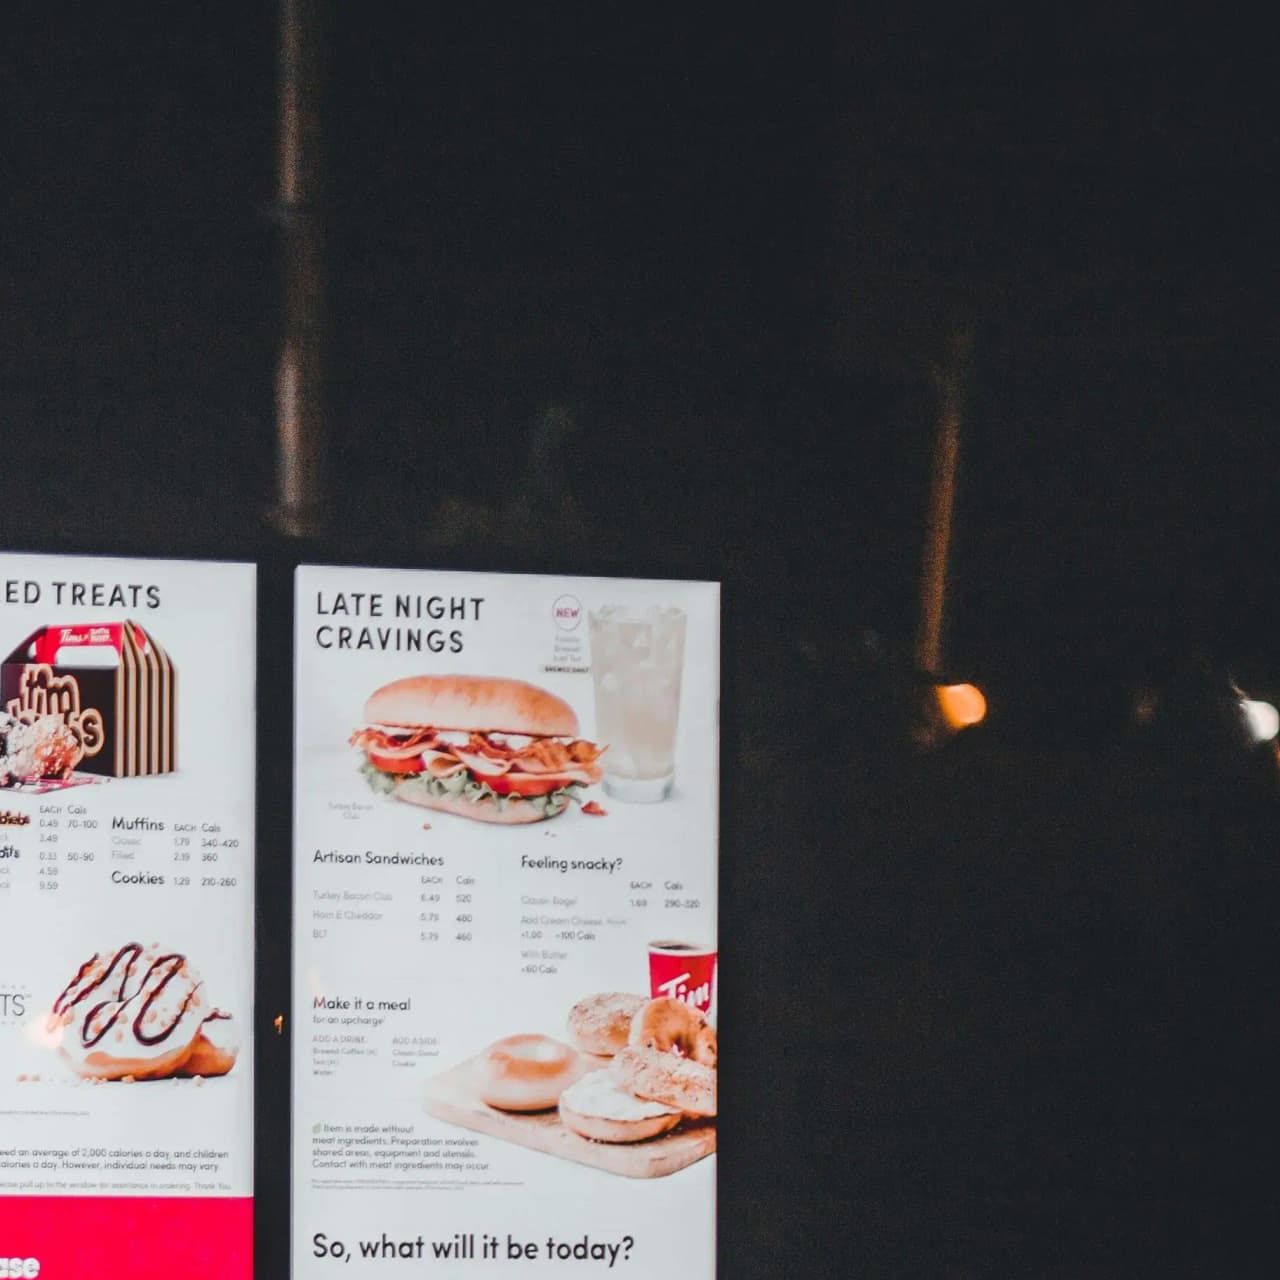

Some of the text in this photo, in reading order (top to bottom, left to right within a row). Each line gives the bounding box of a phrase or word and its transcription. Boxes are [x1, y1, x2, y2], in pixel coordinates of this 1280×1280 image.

[52, 582, 161, 609] TREATS
[317, 592, 485, 621] LATE NIGHT
[556, 607, 580, 618] NEW
[316, 626, 465, 653] CRAVINGS
[112, 816, 164, 831] Muffins
[313, 849, 445, 866] Artisan Sandwiches
[521, 855, 623, 874] Feeling snacky?
[112, 870, 165, 885] Cookies
[313, 996, 411, 1011] Make it a meal
[312, 1233, 634, 1268] So, what will it be today?
